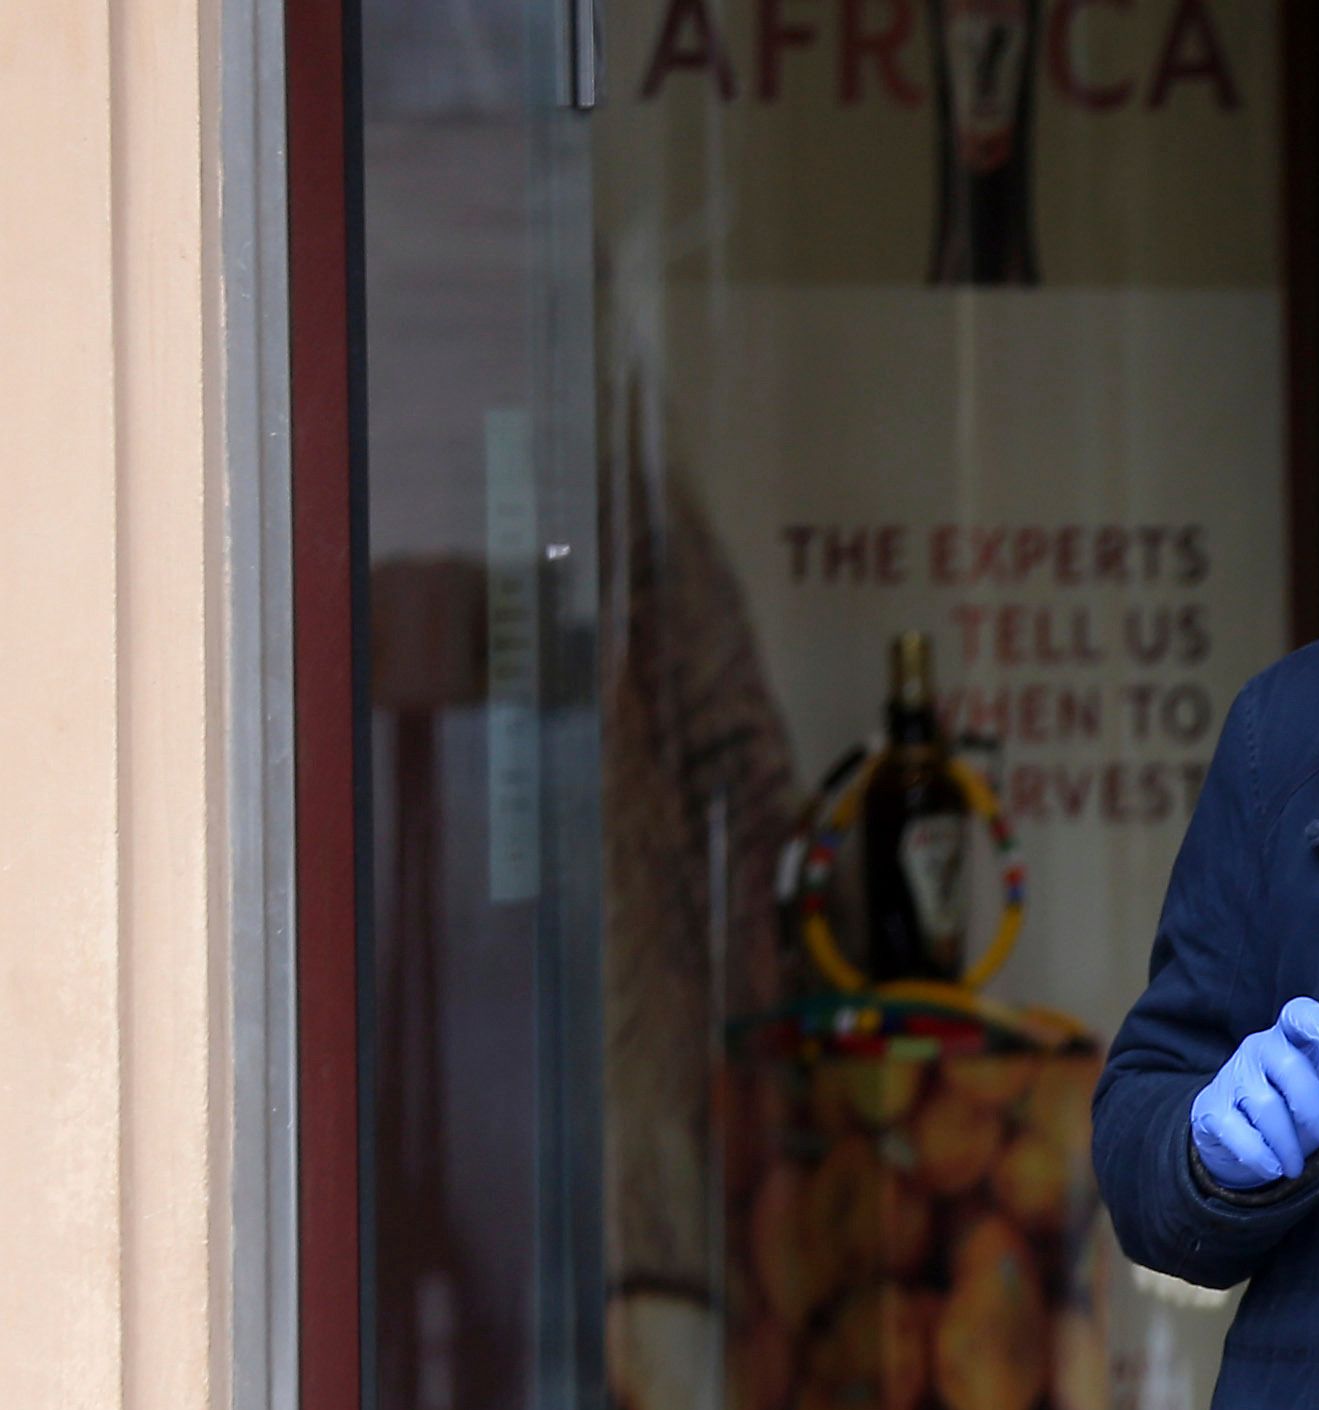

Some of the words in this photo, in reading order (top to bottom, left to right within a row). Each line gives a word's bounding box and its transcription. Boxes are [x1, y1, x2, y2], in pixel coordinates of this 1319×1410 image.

[642, 0, 1239, 110] AFRCA
[783, 525, 906, 585] THE
[928, 524, 1209, 587] EXPERTS
[951, 605, 1102, 666] TELL
[1123, 604, 1210, 667] US
[1124, 683, 1213, 744] TO
[1007, 763, 1210, 826] RVEST
